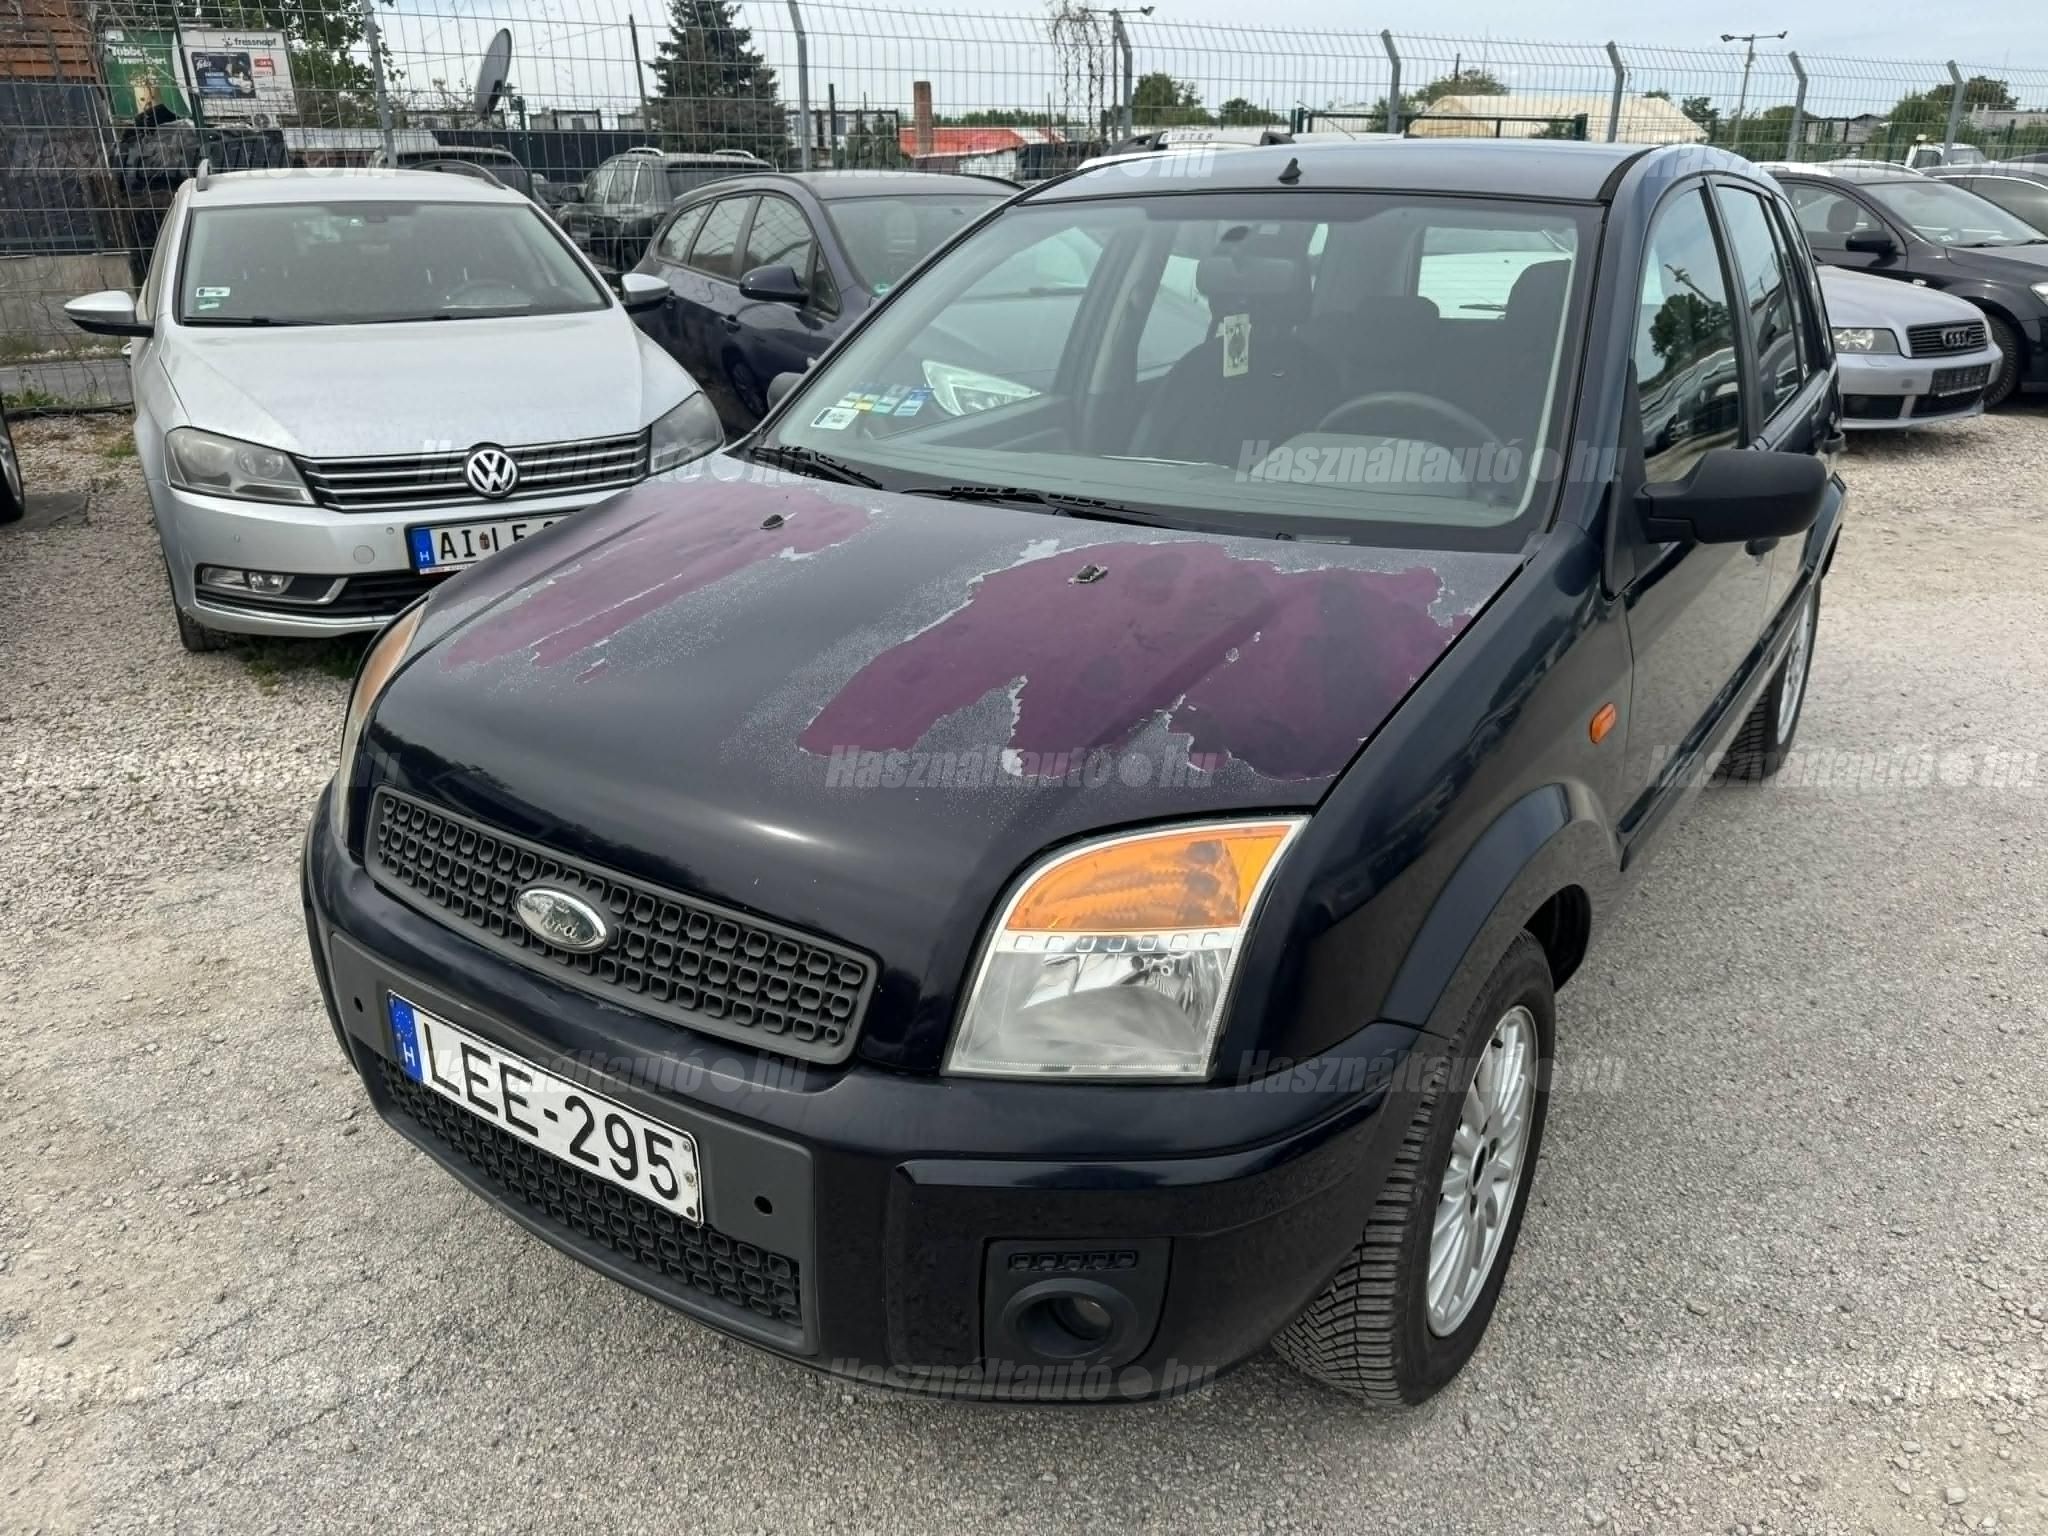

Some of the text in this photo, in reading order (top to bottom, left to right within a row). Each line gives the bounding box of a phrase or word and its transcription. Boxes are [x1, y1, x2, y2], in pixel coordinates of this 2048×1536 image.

[234, 37, 277, 47] fressnapf
[419, 551, 430, 562] H
[402, 1021, 679, 1201] H LEE-295
